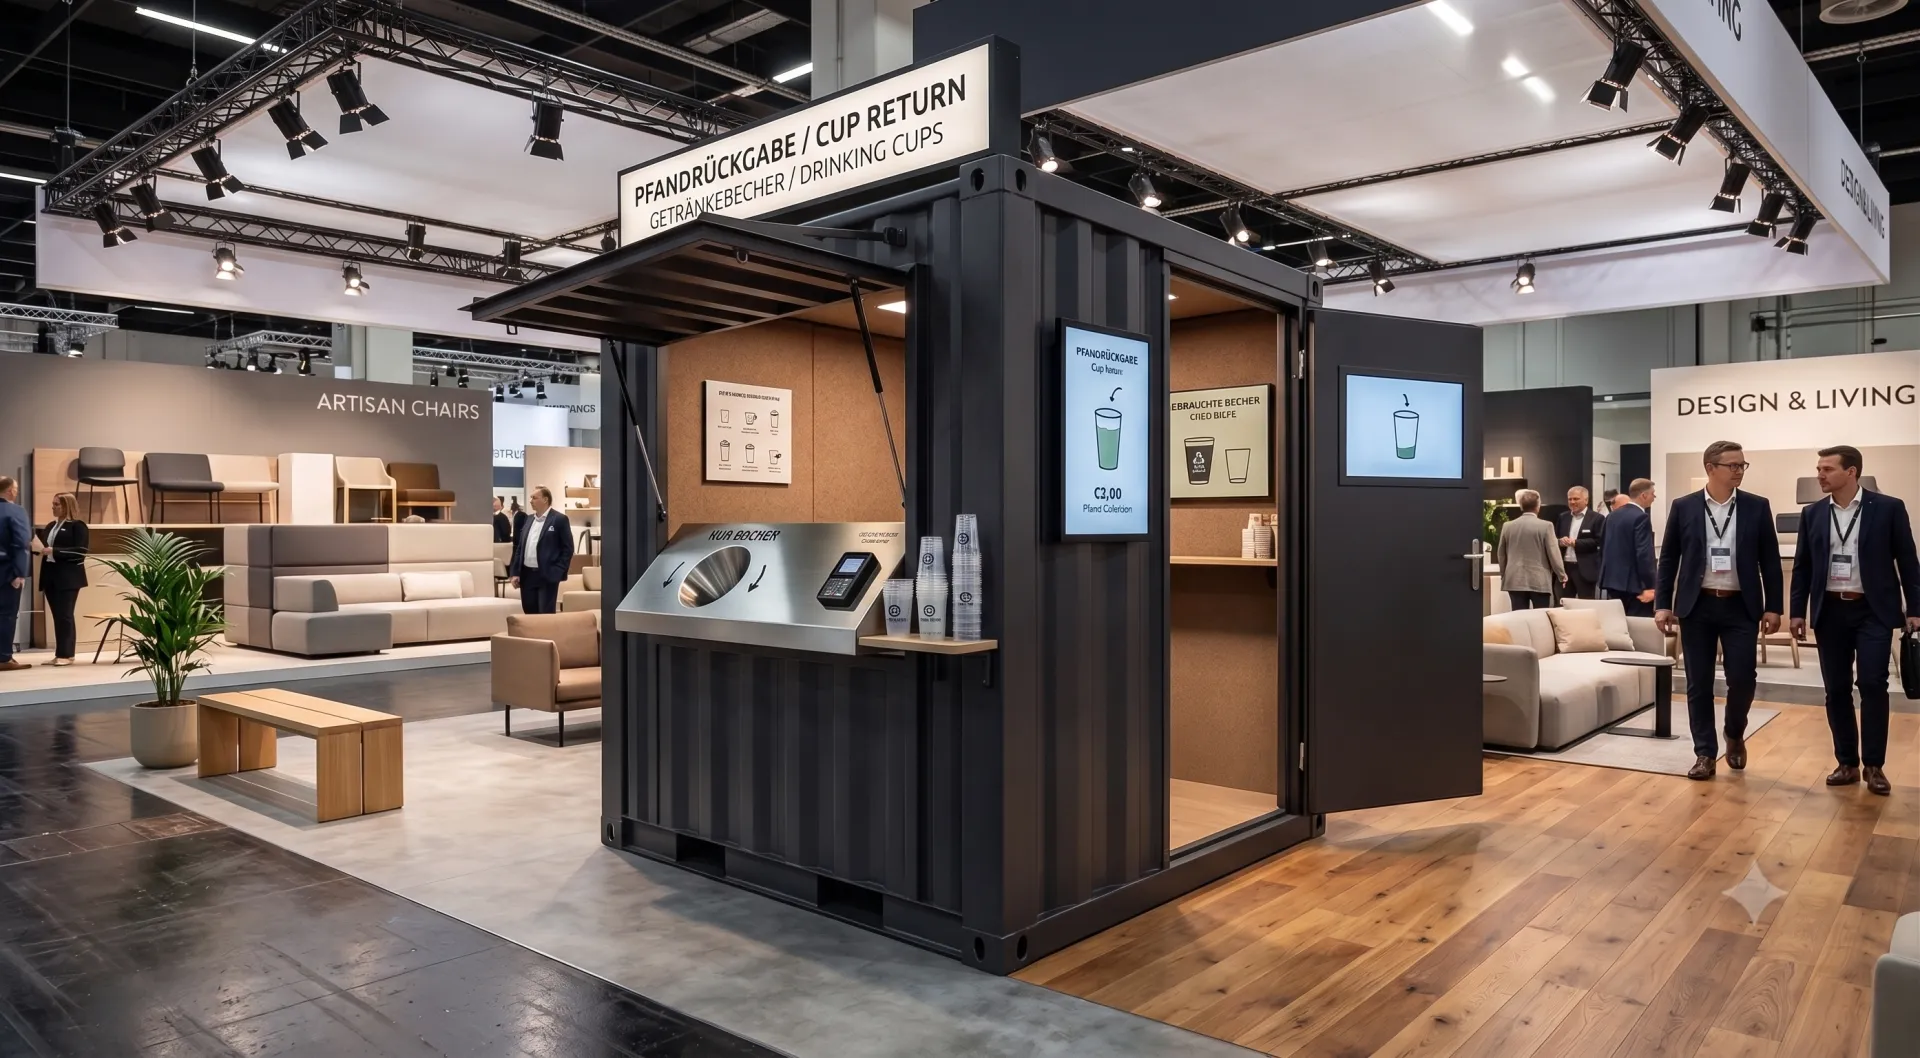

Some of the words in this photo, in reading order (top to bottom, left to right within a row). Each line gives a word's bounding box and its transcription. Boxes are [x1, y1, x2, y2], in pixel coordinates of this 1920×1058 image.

[635, 132, 797, 208] PFANDRÜCKGABE
[801, 125, 811, 156] /
[816, 111, 861, 147] CUP
[867, 74, 966, 132] RETURN
[649, 172, 785, 230] GETRÄNKEBECHER
[788, 165, 797, 192] /
[800, 140, 886, 185] DRINKING
[892, 121, 944, 156] CUPS
[1091, 362, 1105, 375] Cup
[316, 392, 406, 415] ARTISAN
[411, 400, 480, 420] CHAIRS
[1171, 399, 1224, 411] EBRAUCHTE
[1224, 396, 1261, 407] BECHER
[1677, 392, 1778, 417] DESIGN
[1788, 390, 1807, 411] &
[1816, 384, 1916, 410] LIVING
